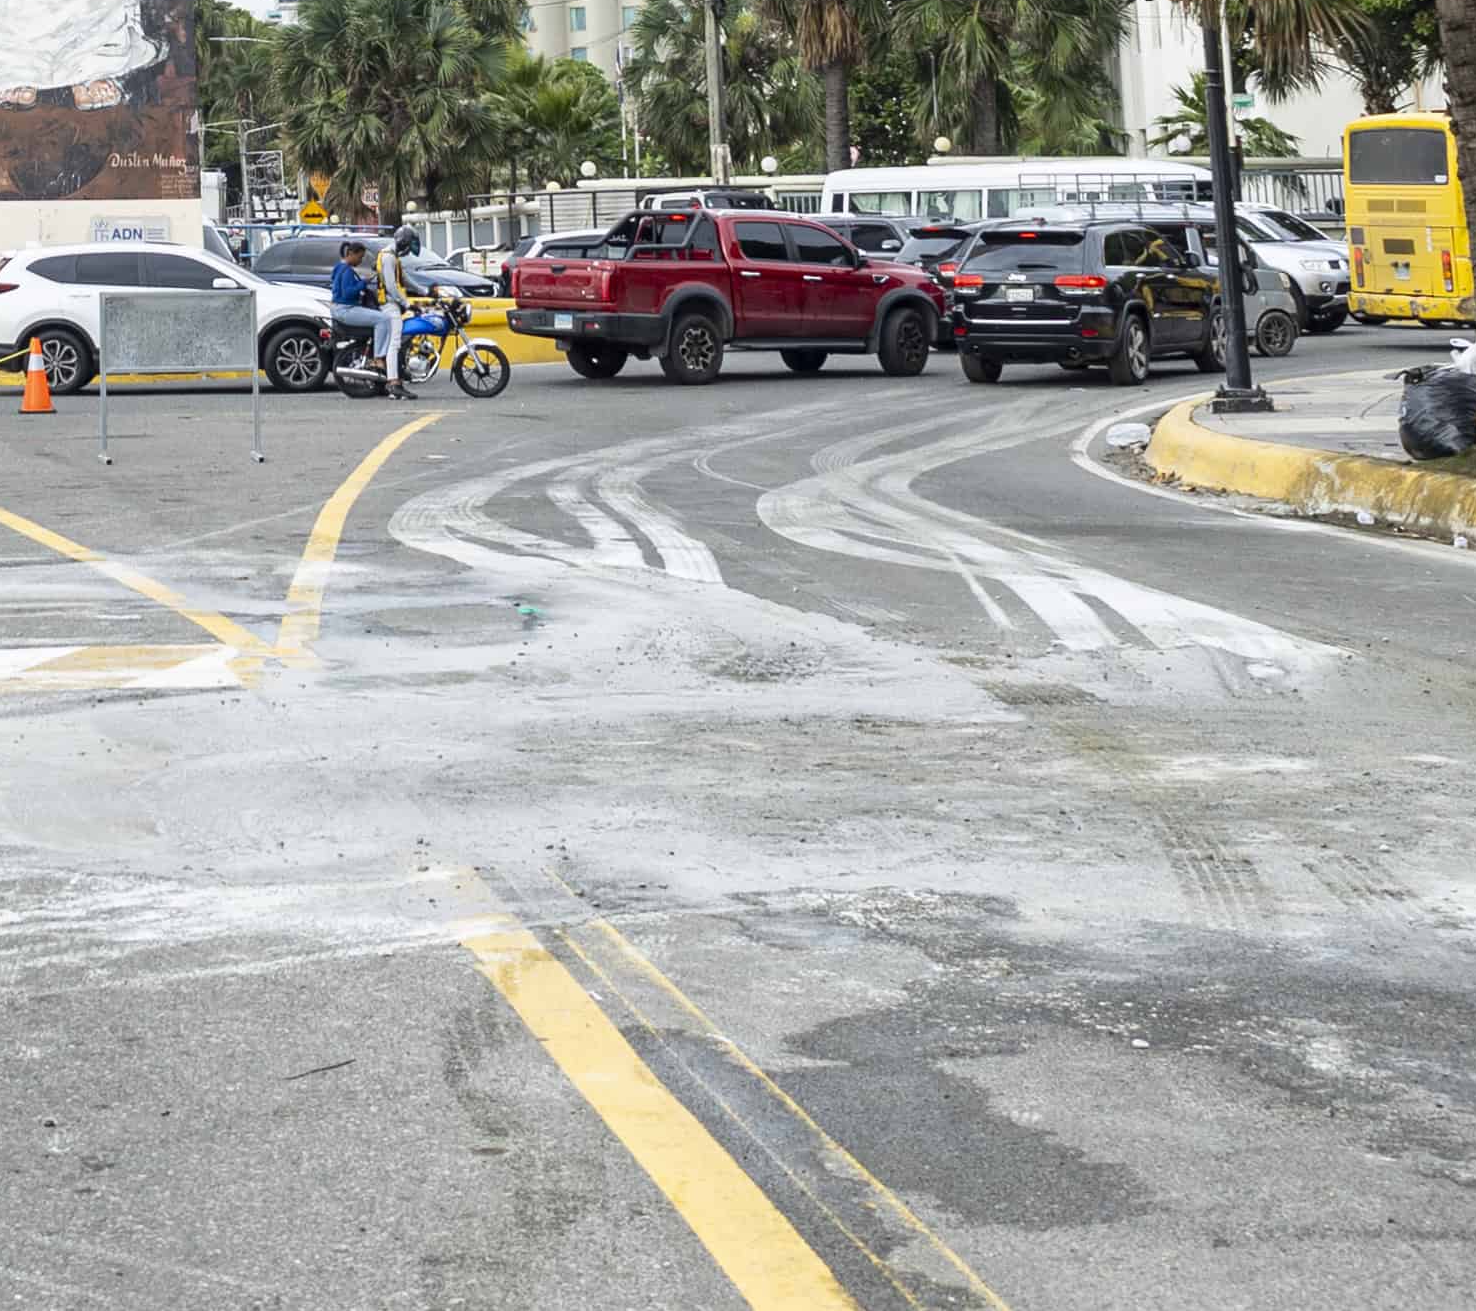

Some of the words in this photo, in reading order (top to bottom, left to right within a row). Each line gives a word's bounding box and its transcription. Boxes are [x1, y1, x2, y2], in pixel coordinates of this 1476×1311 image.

[151, 152, 187, 176] Muñoz
[112, 227, 144, 241] ADN
[1007, 272, 1027, 282] Jeep
